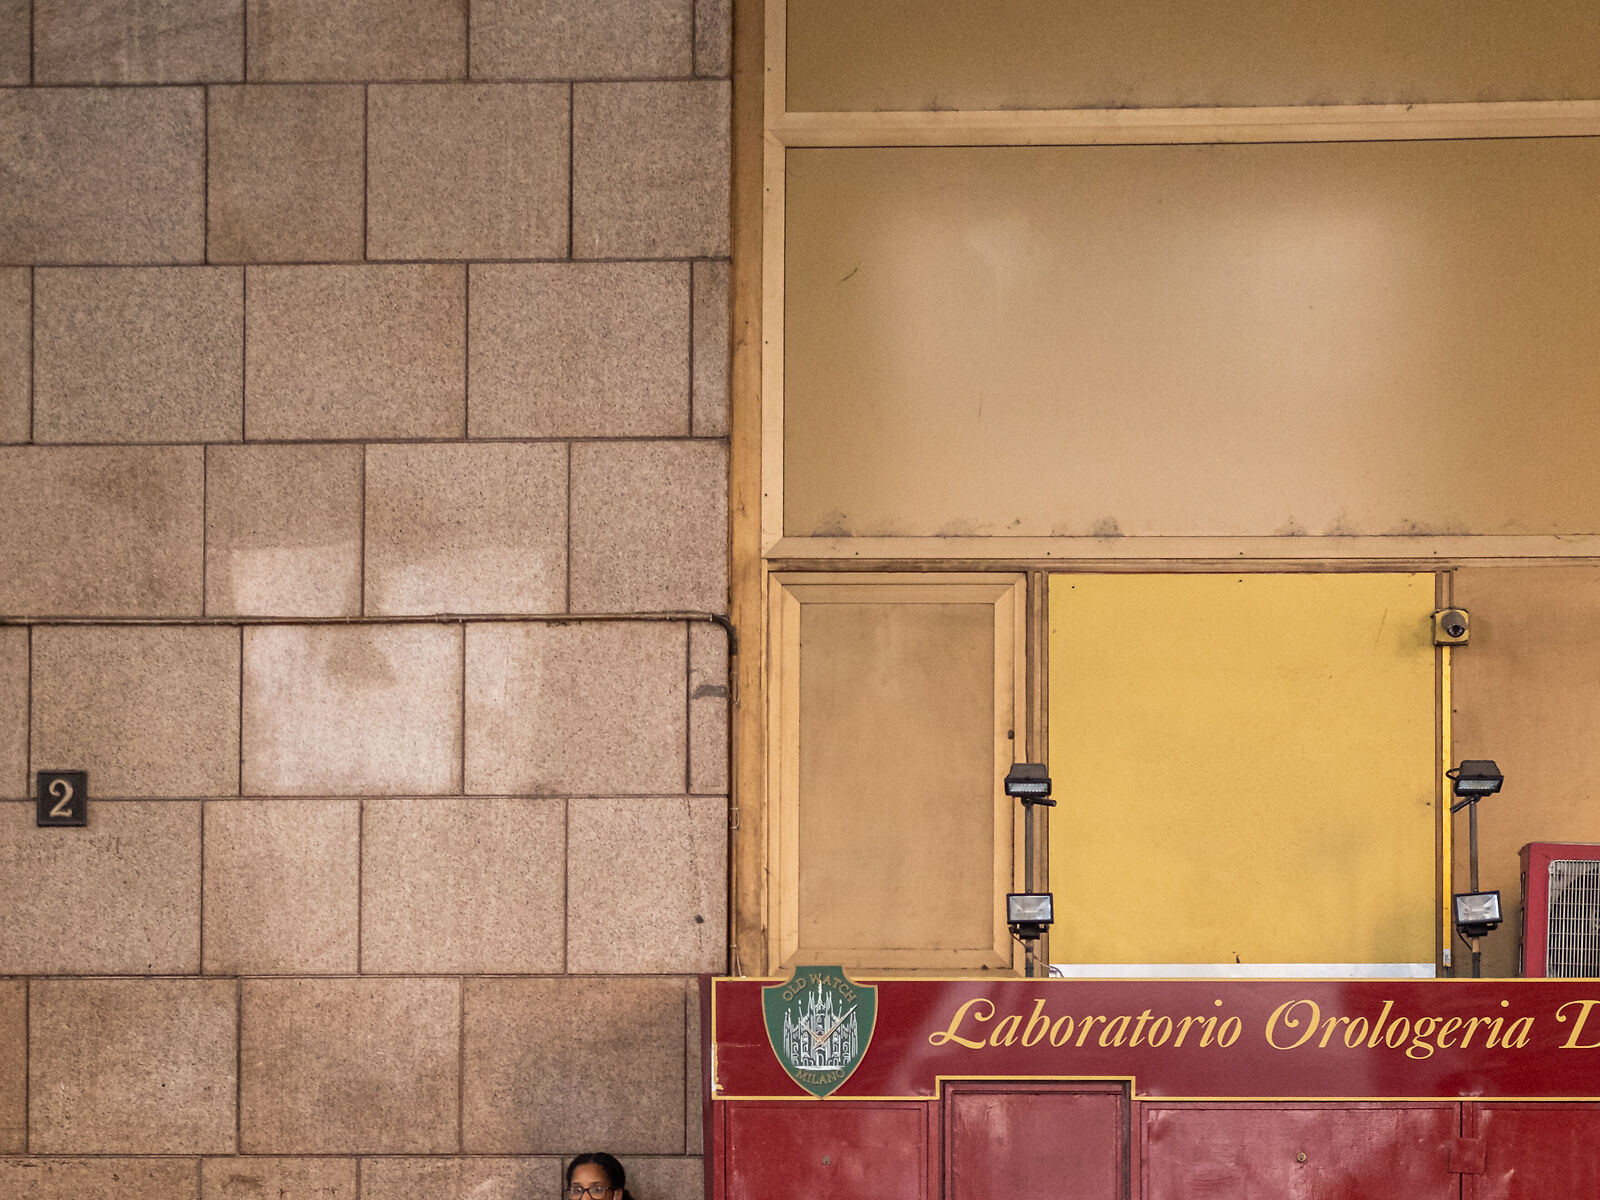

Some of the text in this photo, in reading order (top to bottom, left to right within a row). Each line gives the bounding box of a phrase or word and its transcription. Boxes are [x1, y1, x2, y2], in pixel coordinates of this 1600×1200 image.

[49, 779, 74, 817] 2
[782, 973, 857, 1003] OLD WATCH
[928, 998, 1242, 1049] Laboratorio
[1265, 999, 1535, 1060] Orologeria
[795, 1068, 845, 1084] MILANO
